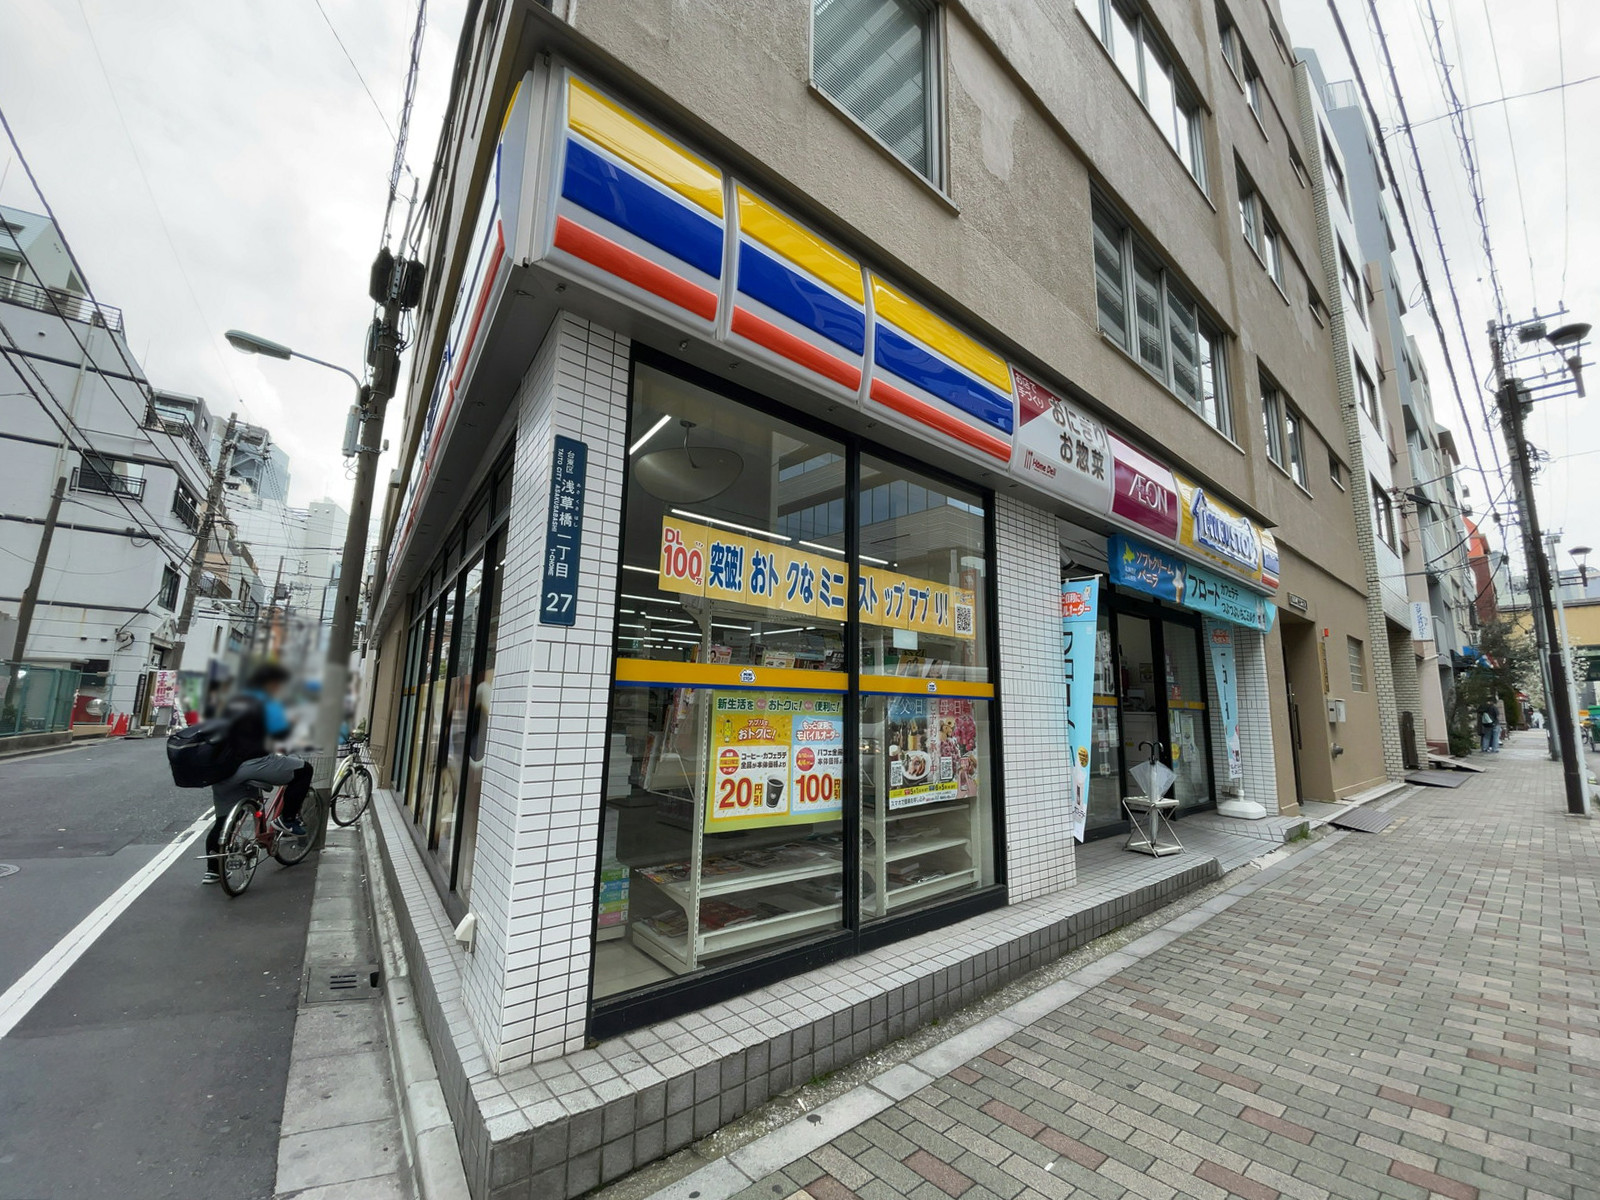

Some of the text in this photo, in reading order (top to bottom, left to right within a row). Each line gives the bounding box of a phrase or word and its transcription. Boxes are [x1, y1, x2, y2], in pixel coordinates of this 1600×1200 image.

[1048, 396, 1106, 449] おにぎり
[566, 450, 576, 475] 台東区
[1060, 431, 1105, 481] お惣菜
[551, 448, 564, 533] TAITO CITY ASAKUSABASHI
[555, 479, 576, 579] 浅草橋一丁目
[664, 528, 683, 546] DL
[547, 548, 556, 577] 1-CHOME
[663, 546, 703, 586] 100万
[1135, 552, 1175, 576] ソフトクリーム
[1137, 570, 1159, 588] バニラ
[1188, 574, 1220, 607] フロート
[546, 592, 573, 613] 27
[717, 698, 754, 710] 新生活を
[768, 699, 802, 711] おトクに!
[814, 701, 840, 712] 便利に!
[738, 727, 777, 741] おトクに!
[796, 729, 840, 741] モバイルオーダー
